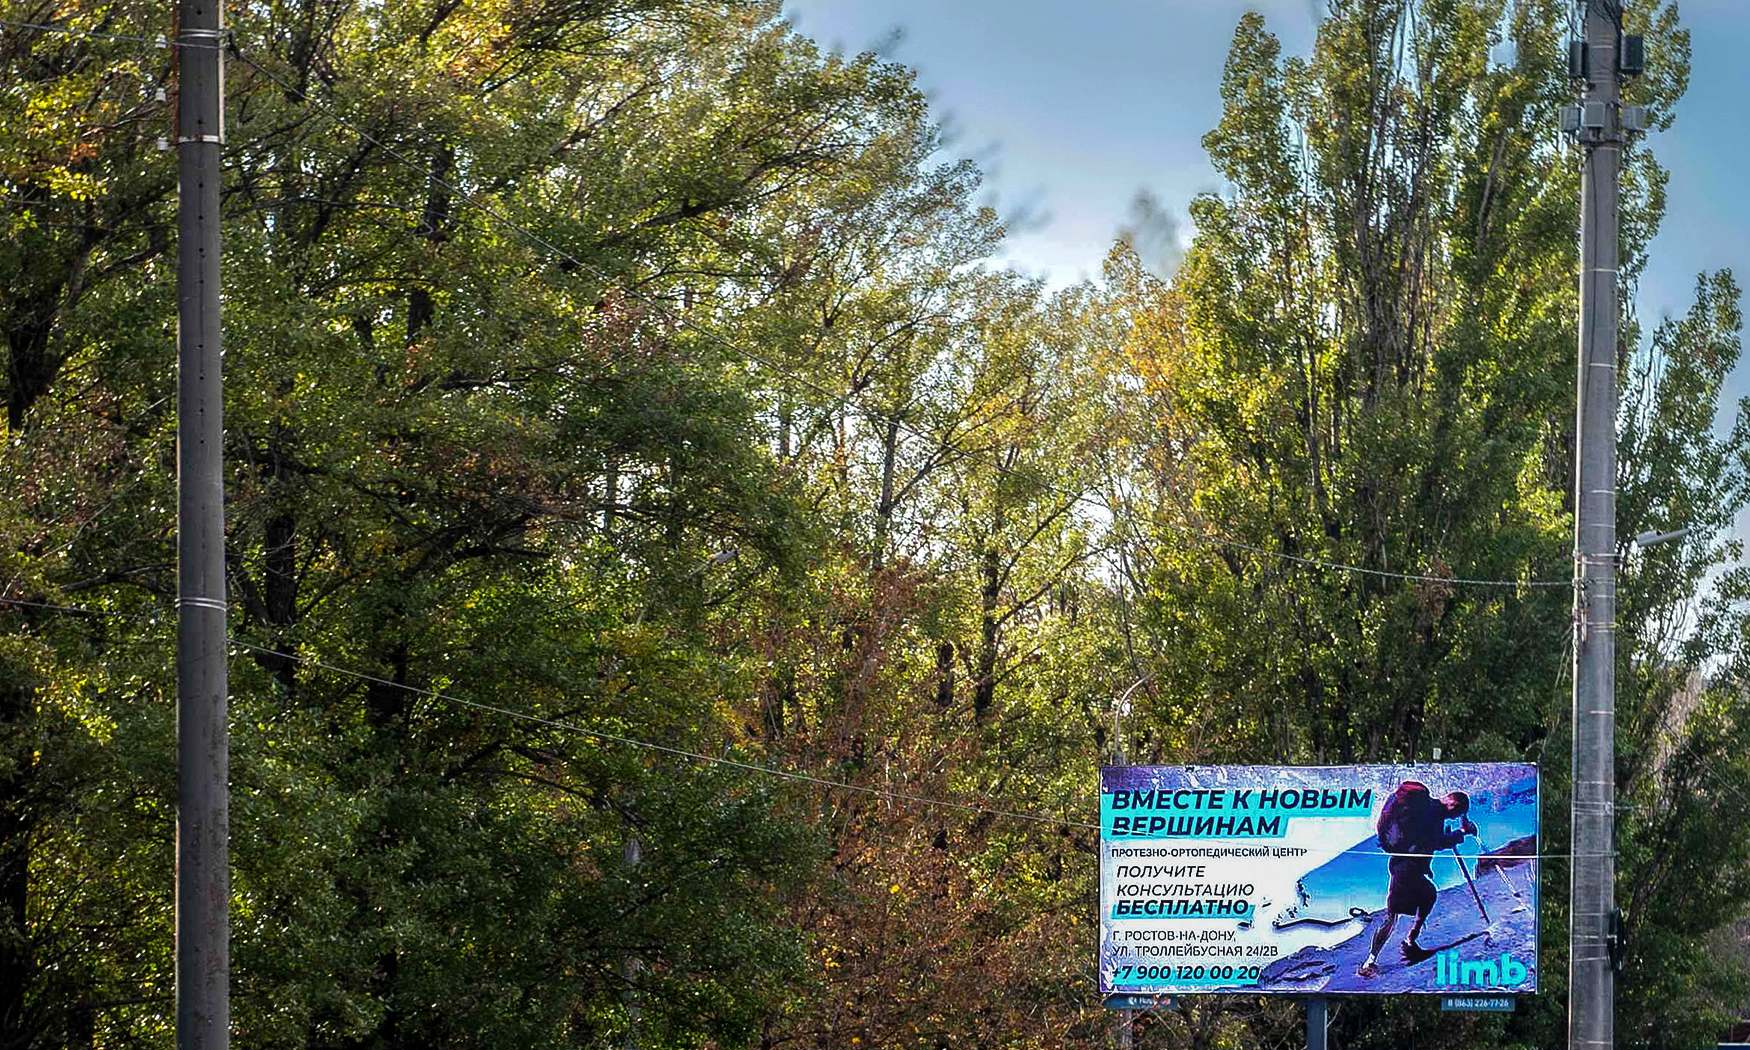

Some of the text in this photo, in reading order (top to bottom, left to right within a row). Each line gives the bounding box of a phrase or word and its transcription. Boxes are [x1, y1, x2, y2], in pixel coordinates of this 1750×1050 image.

[1111, 788, 1373, 809] ВМЕСТЕ К НОВЫМ
[1111, 816, 1282, 836] ВЕРШИНАМ
[1111, 846, 1307, 859] ПРОТЕЗНО-ОРТОПЕДИЧЕСКИЙ ЦЕНТР
[1117, 865, 1206, 878] ПОЛУЧИТЕ
[1116, 884, 1255, 898] КОНСУЛЬТАЦИЮ
[1116, 899, 1249, 915] БЕСПЛАТНО
[1112, 930, 1236, 943] Г. РОСТОВ-НА-ДОНУ,
[1112, 946, 1131, 957] УЛ.
[1135, 944, 1243, 957] ТРОЛЛЕЙБУСНАЯ
[1112, 965, 1260, 980] +7 900 120 00 20
[1436, 950, 1528, 986] limb
